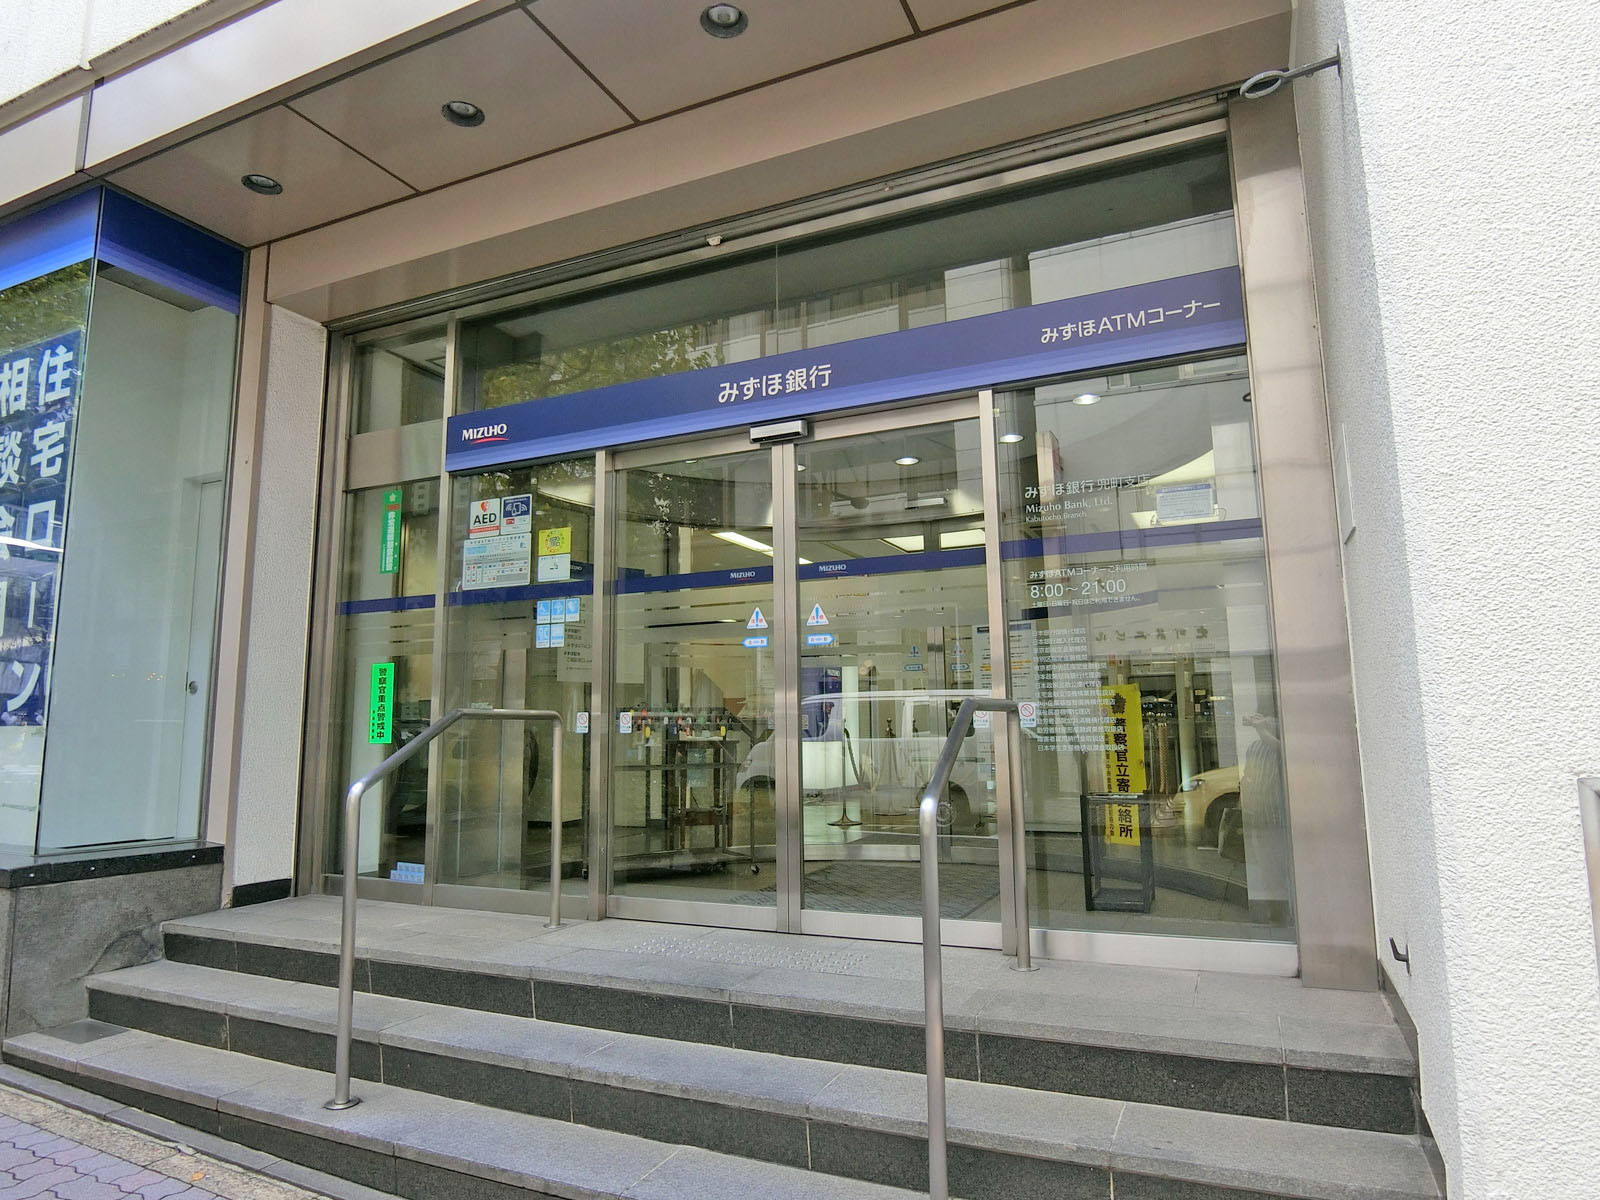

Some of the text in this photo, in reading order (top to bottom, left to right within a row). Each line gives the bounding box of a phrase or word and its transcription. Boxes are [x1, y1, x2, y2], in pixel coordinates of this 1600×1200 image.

[1040, 298, 1221, 345] みずほATMコーナー
[717, 364, 832, 404] みずほ銀行
[462, 423, 508, 442] MIZUHO
[1025, 479, 1094, 499] みずほ銀行
[1025, 501, 1061, 514] Mizuho
[1095, 496, 1113, 507] Ltd.
[473, 512, 497, 525] AED
[1025, 510, 1087, 523] Kabutocho Branch
[8, 344, 74, 712] 住宅ローン
[730, 570, 756, 579] MIZUHO
[819, 563, 847, 572] MIZUHO
[1113, 718, 1133, 839] 警察官立寄絡所
